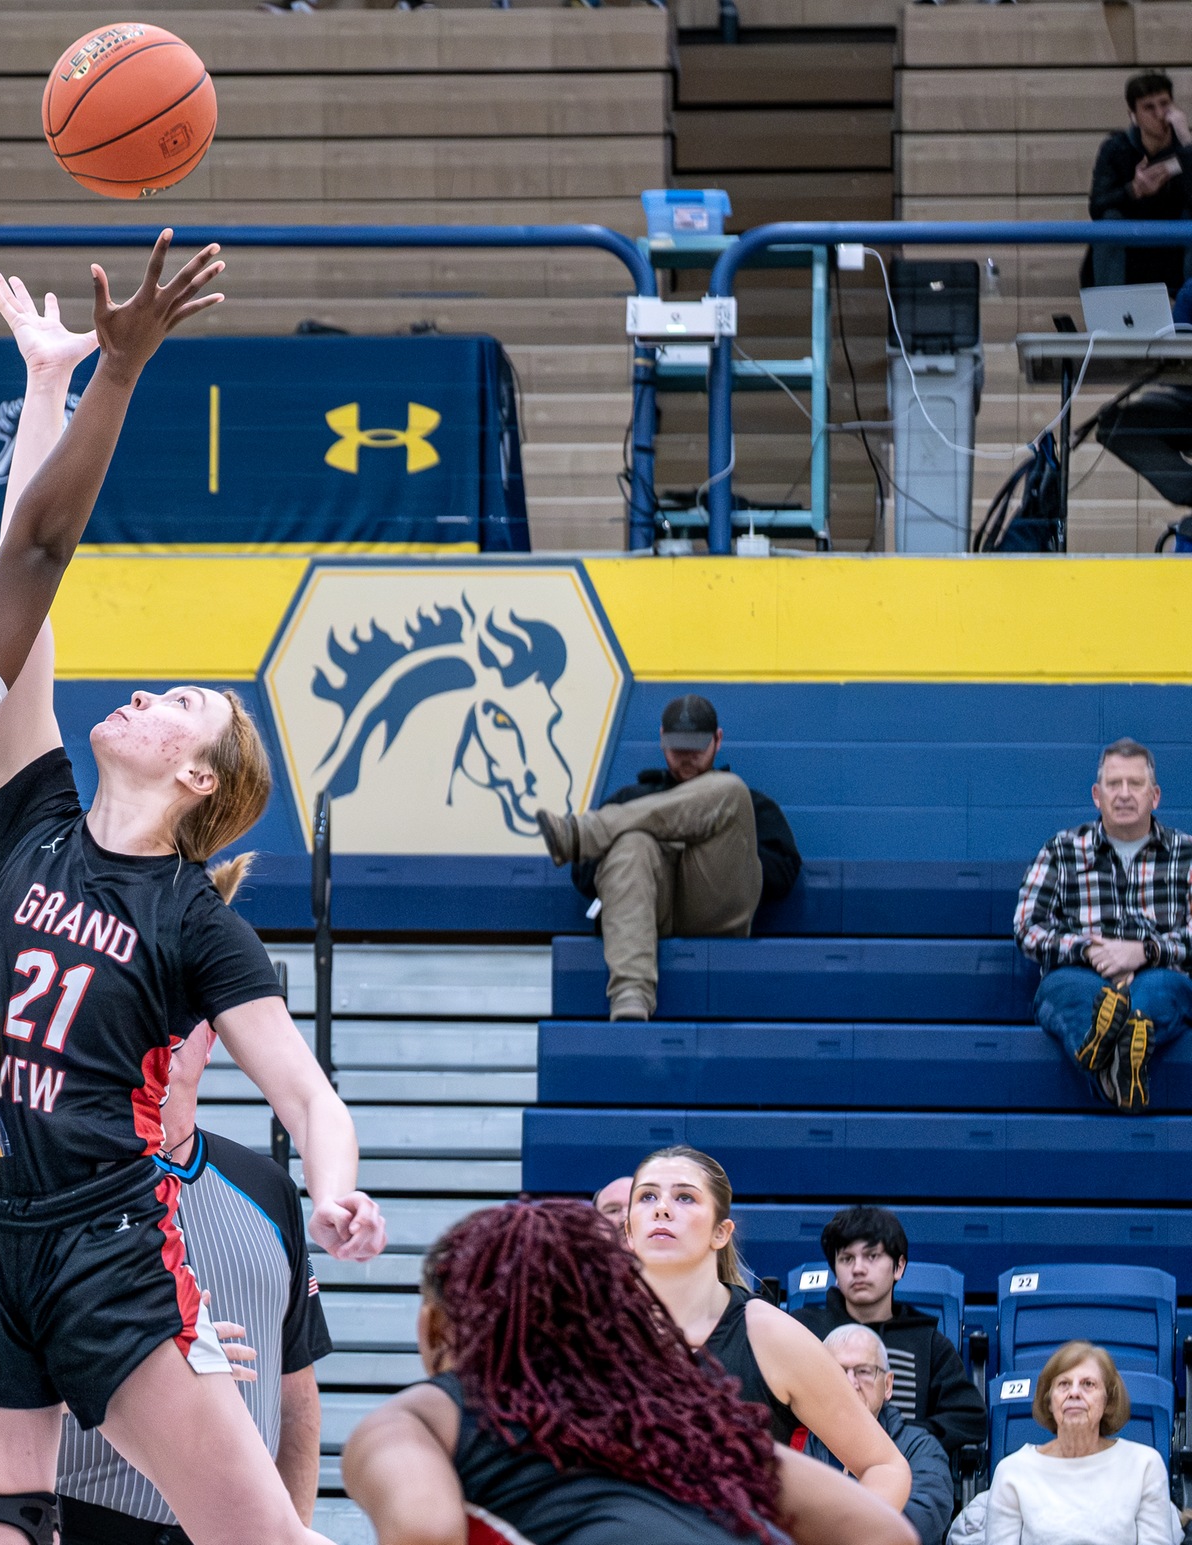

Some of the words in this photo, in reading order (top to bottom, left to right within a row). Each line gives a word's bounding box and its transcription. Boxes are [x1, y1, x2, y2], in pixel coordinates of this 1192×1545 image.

[13, 882, 139, 964] GRAND
[3, 947, 95, 1054] 21
[808, 1274, 820, 1285] 21
[1018, 1277, 1032, 1288] 22
[1009, 1383, 1023, 1395] 22
